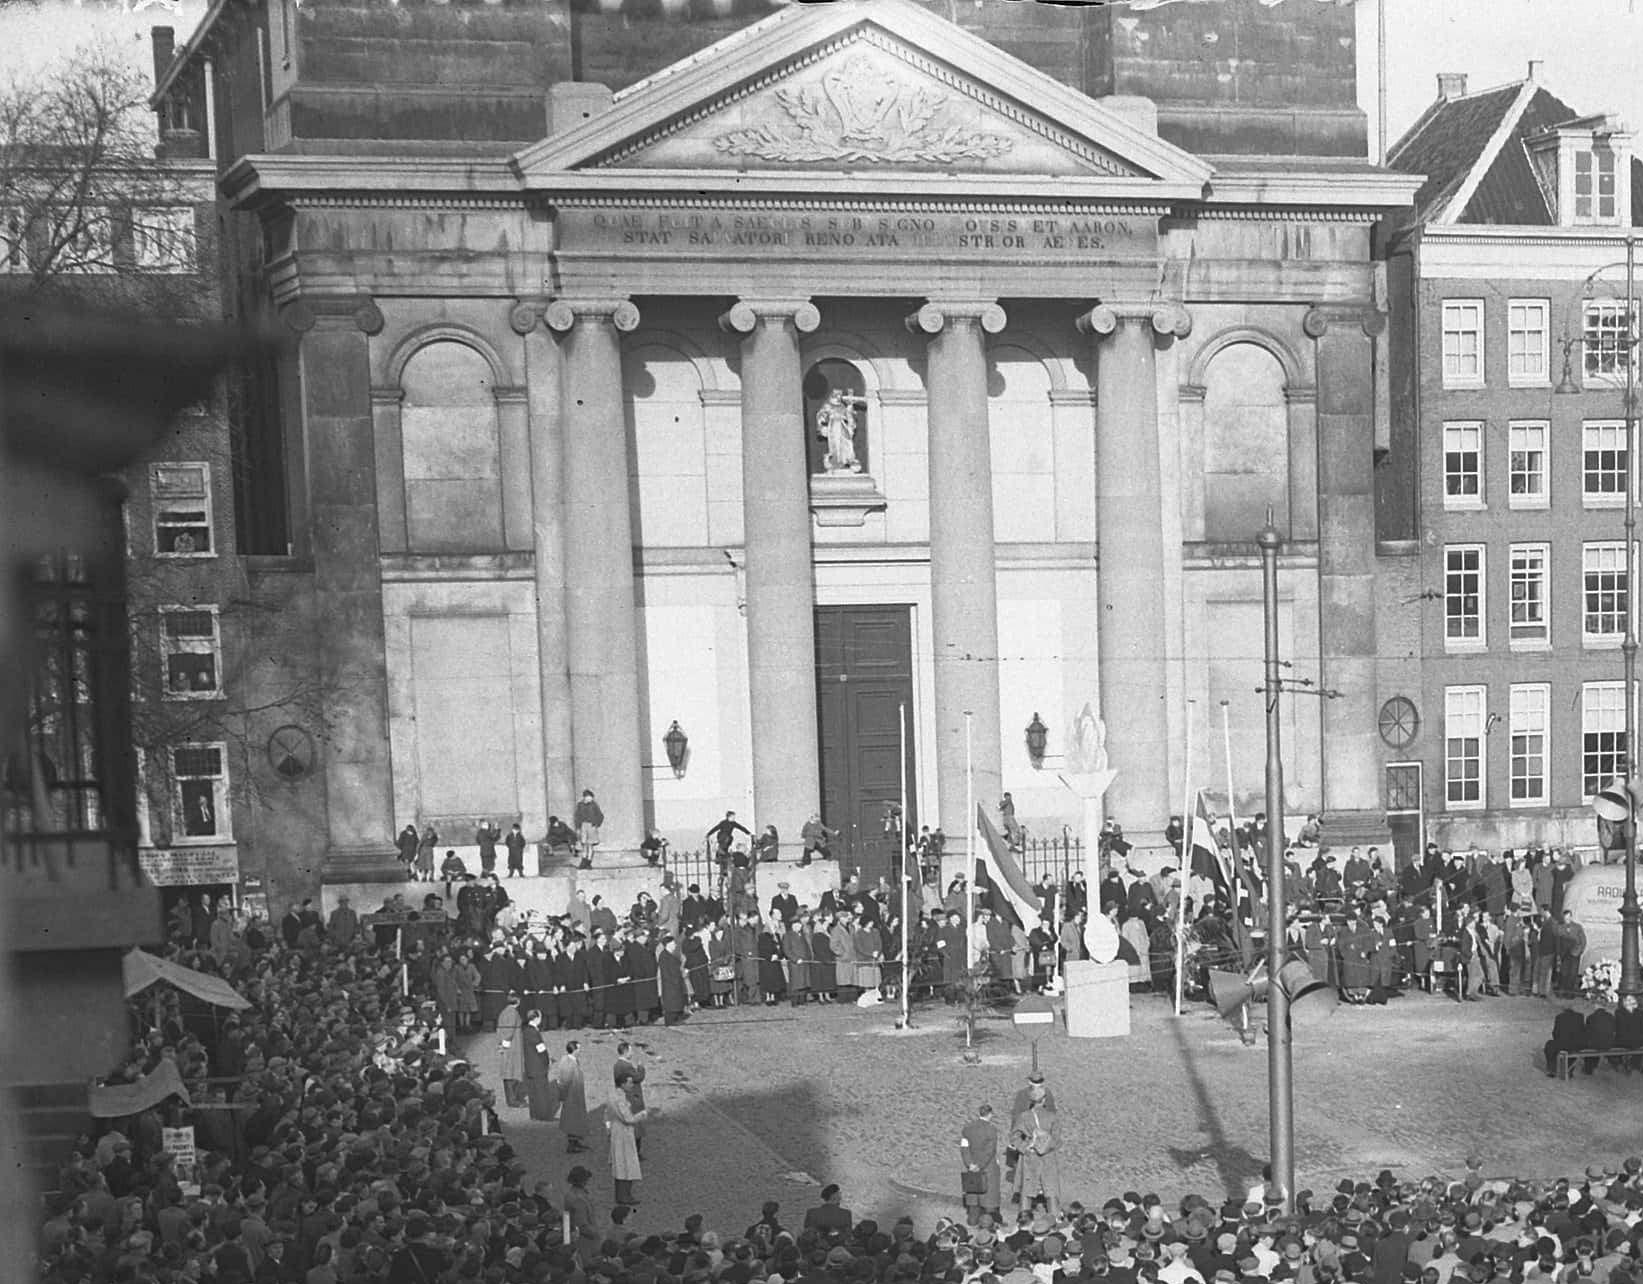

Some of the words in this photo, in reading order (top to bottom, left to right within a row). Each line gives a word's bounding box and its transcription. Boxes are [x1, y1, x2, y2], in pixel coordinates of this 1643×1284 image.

[1033, 220, 1058, 233] ET
[623, 232, 672, 244] STAT
[805, 232, 899, 246] RENOATA
